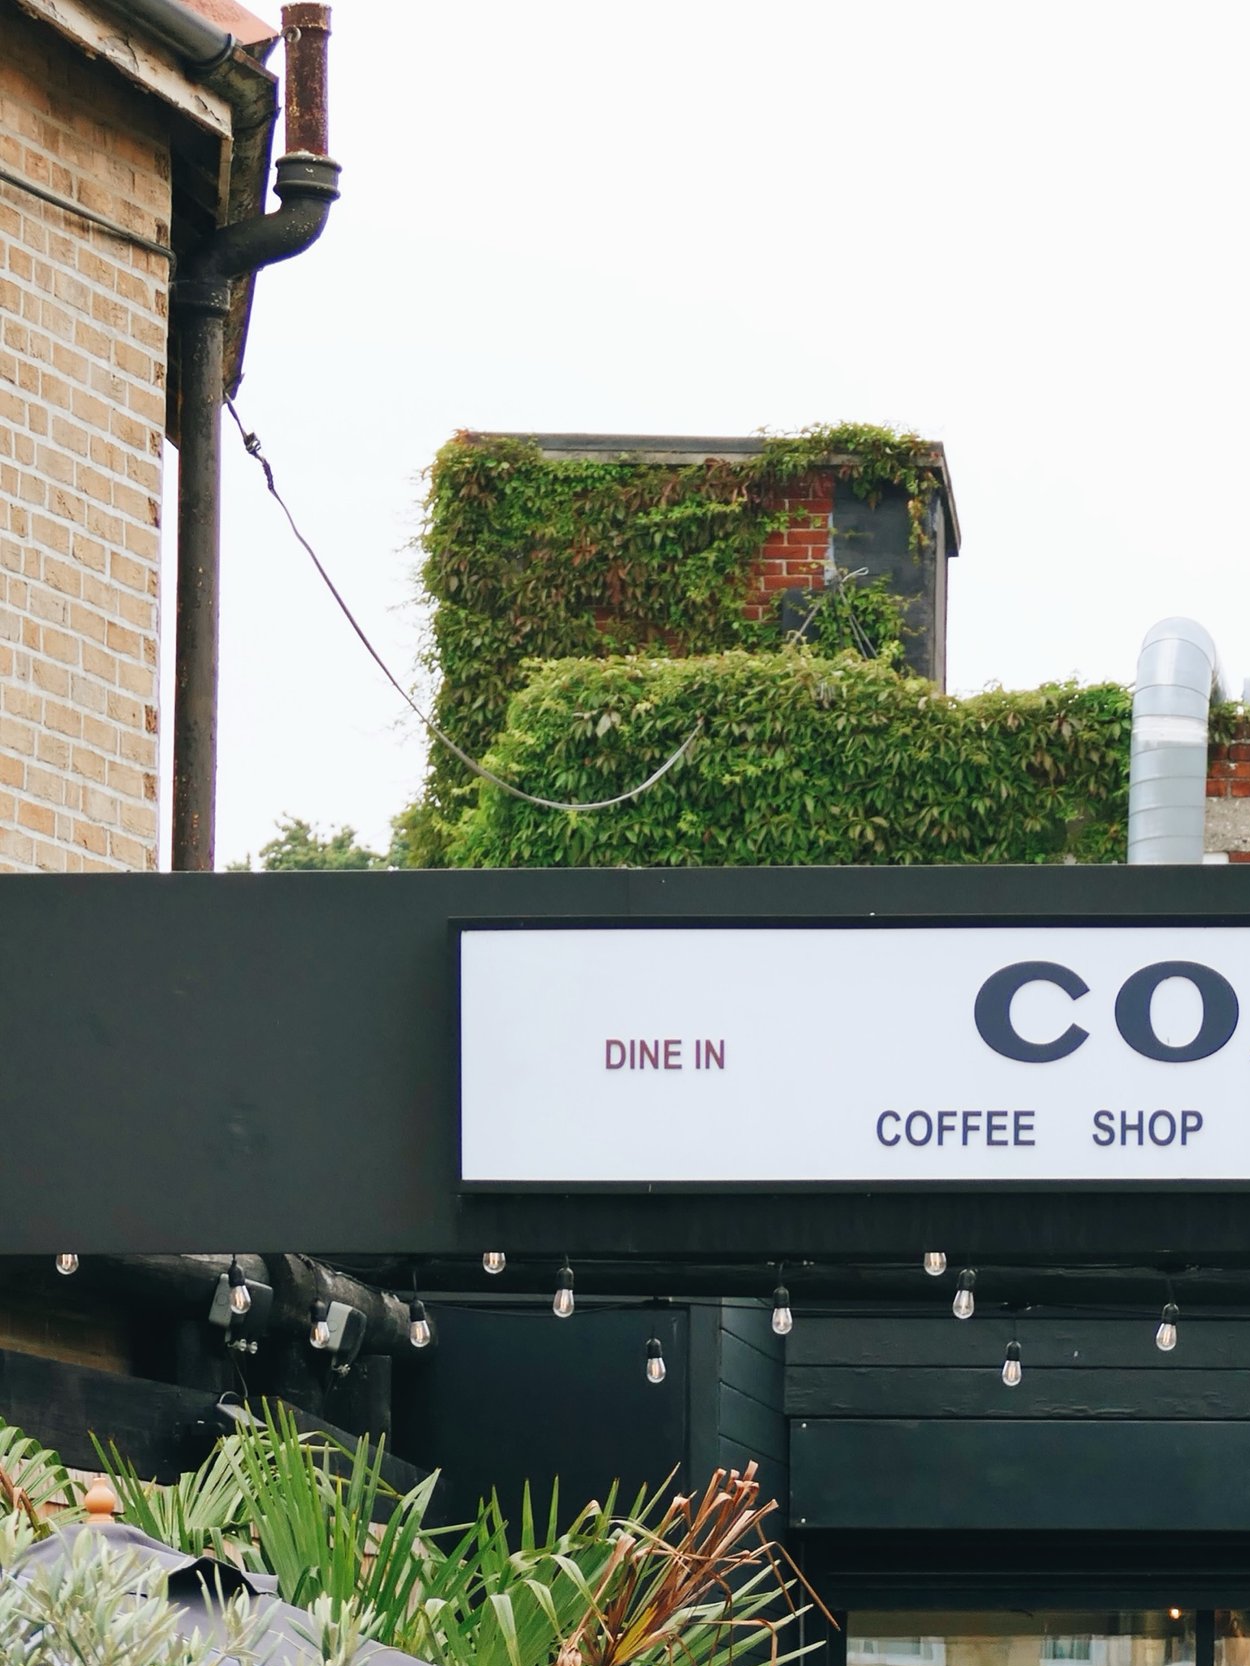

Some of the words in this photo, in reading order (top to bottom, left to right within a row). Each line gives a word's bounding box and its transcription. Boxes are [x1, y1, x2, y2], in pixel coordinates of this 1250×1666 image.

[605, 1039, 682, 1070] DINE
[695, 1039, 725, 1070] IN
[876, 1110, 1036, 1147] COFFEE
[1092, 1110, 1203, 1147] SHOP
